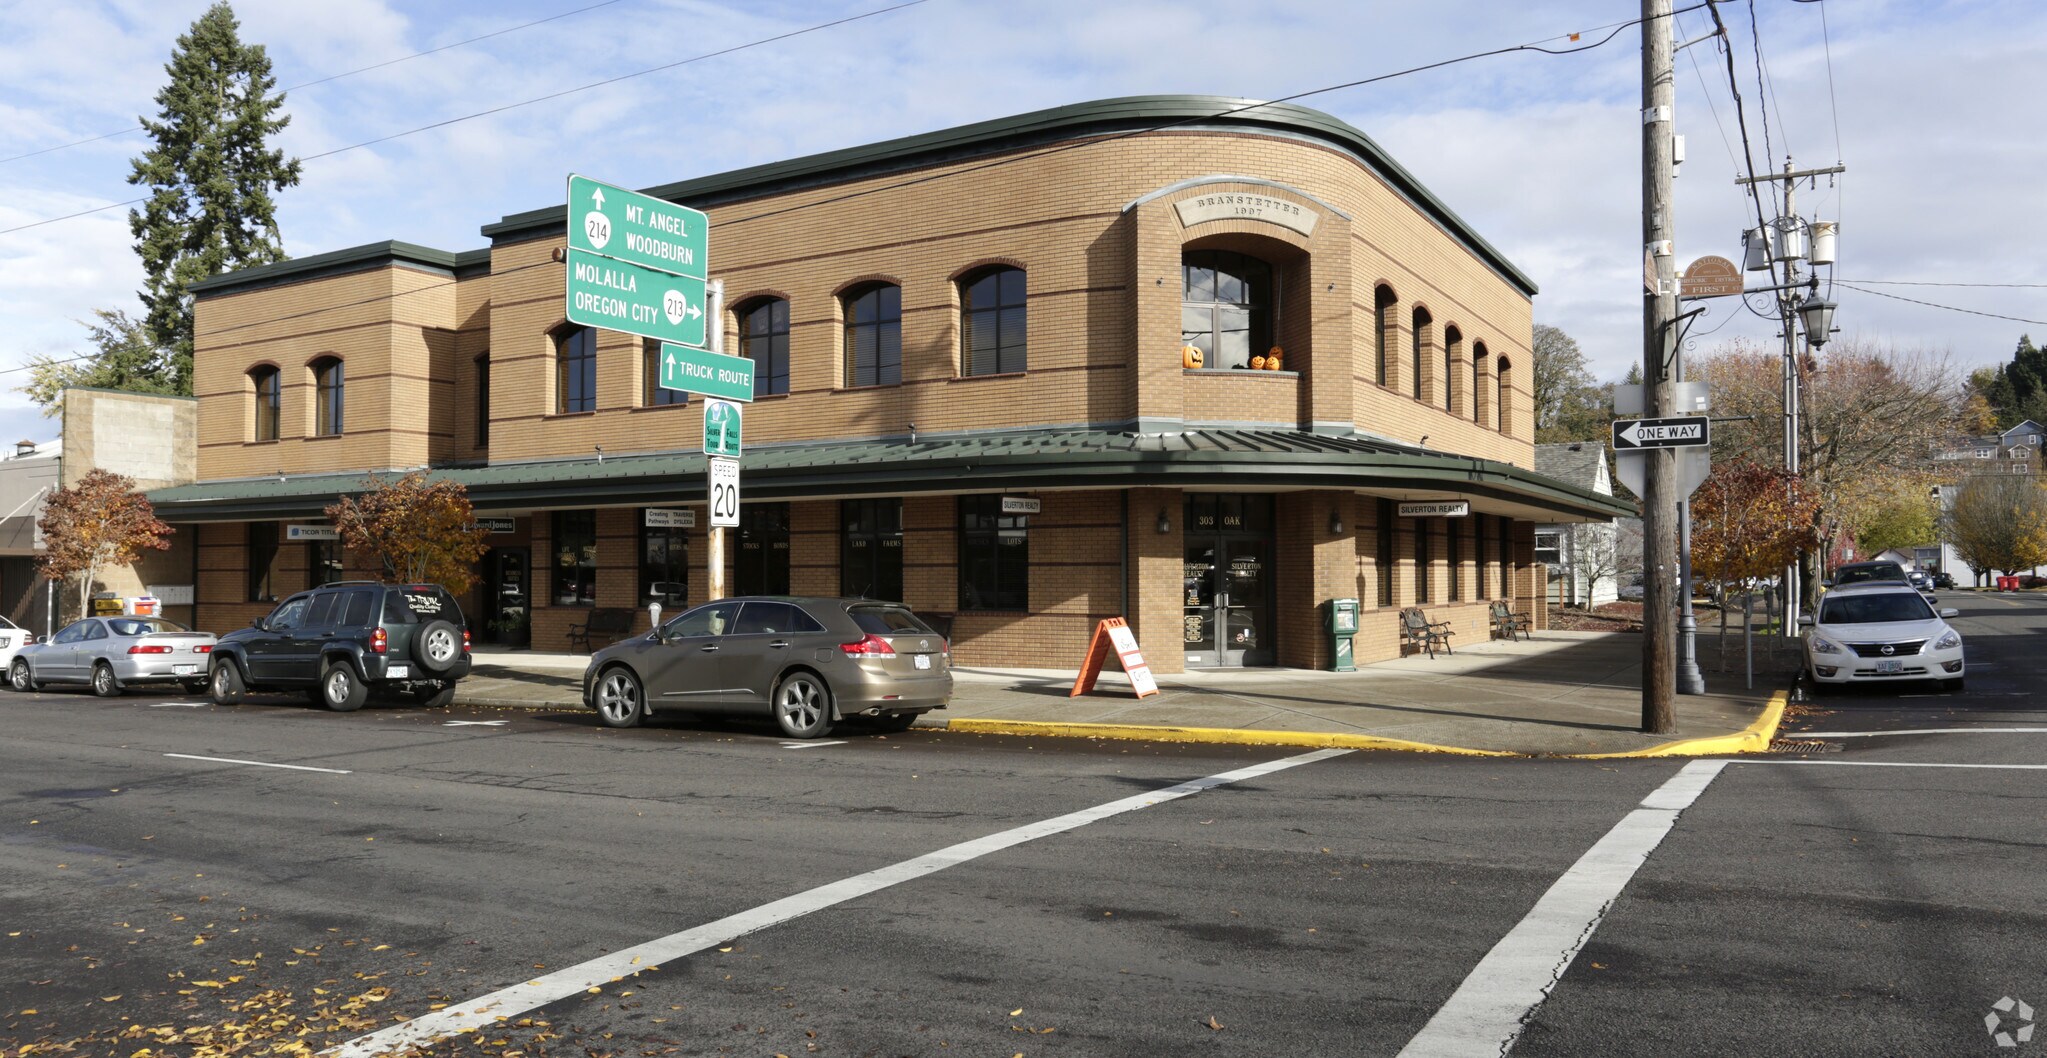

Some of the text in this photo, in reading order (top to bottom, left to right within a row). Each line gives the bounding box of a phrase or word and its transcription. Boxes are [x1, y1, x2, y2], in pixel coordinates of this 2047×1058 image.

[1197, 195, 1300, 216] BRANSTETTER
[1234, 207, 1262, 216] 1997
[626, 203, 688, 238] MT. ANGEL
[588, 220, 607, 241] 214
[626, 231, 693, 266] WOODBURN
[1692, 256, 1731, 270] NATIONAL
[575, 261, 637, 293] MOLALLA
[1692, 285, 1729, 293] FIRST
[575, 291, 659, 325] OREGON CITY
[667, 298, 684, 318] 213
[680, 361, 750, 387] TRUCK ROUTE
[1637, 425, 1698, 440] ONE WAY
[714, 464, 736, 478] SPEED
[714, 482, 736, 518] 20
[1004, 501, 1039, 510] SILVERTON REALTY
[1401, 504, 1464, 514] SILVERTON REALTY
[492, 520, 513, 530] Jones
[1199, 516, 1241, 526] 303 OAK
[851, 539, 902, 548] LAND FARMS
[1007, 537, 1022, 545] LOTS
[1231, 562, 1261, 570] SILVERTON
